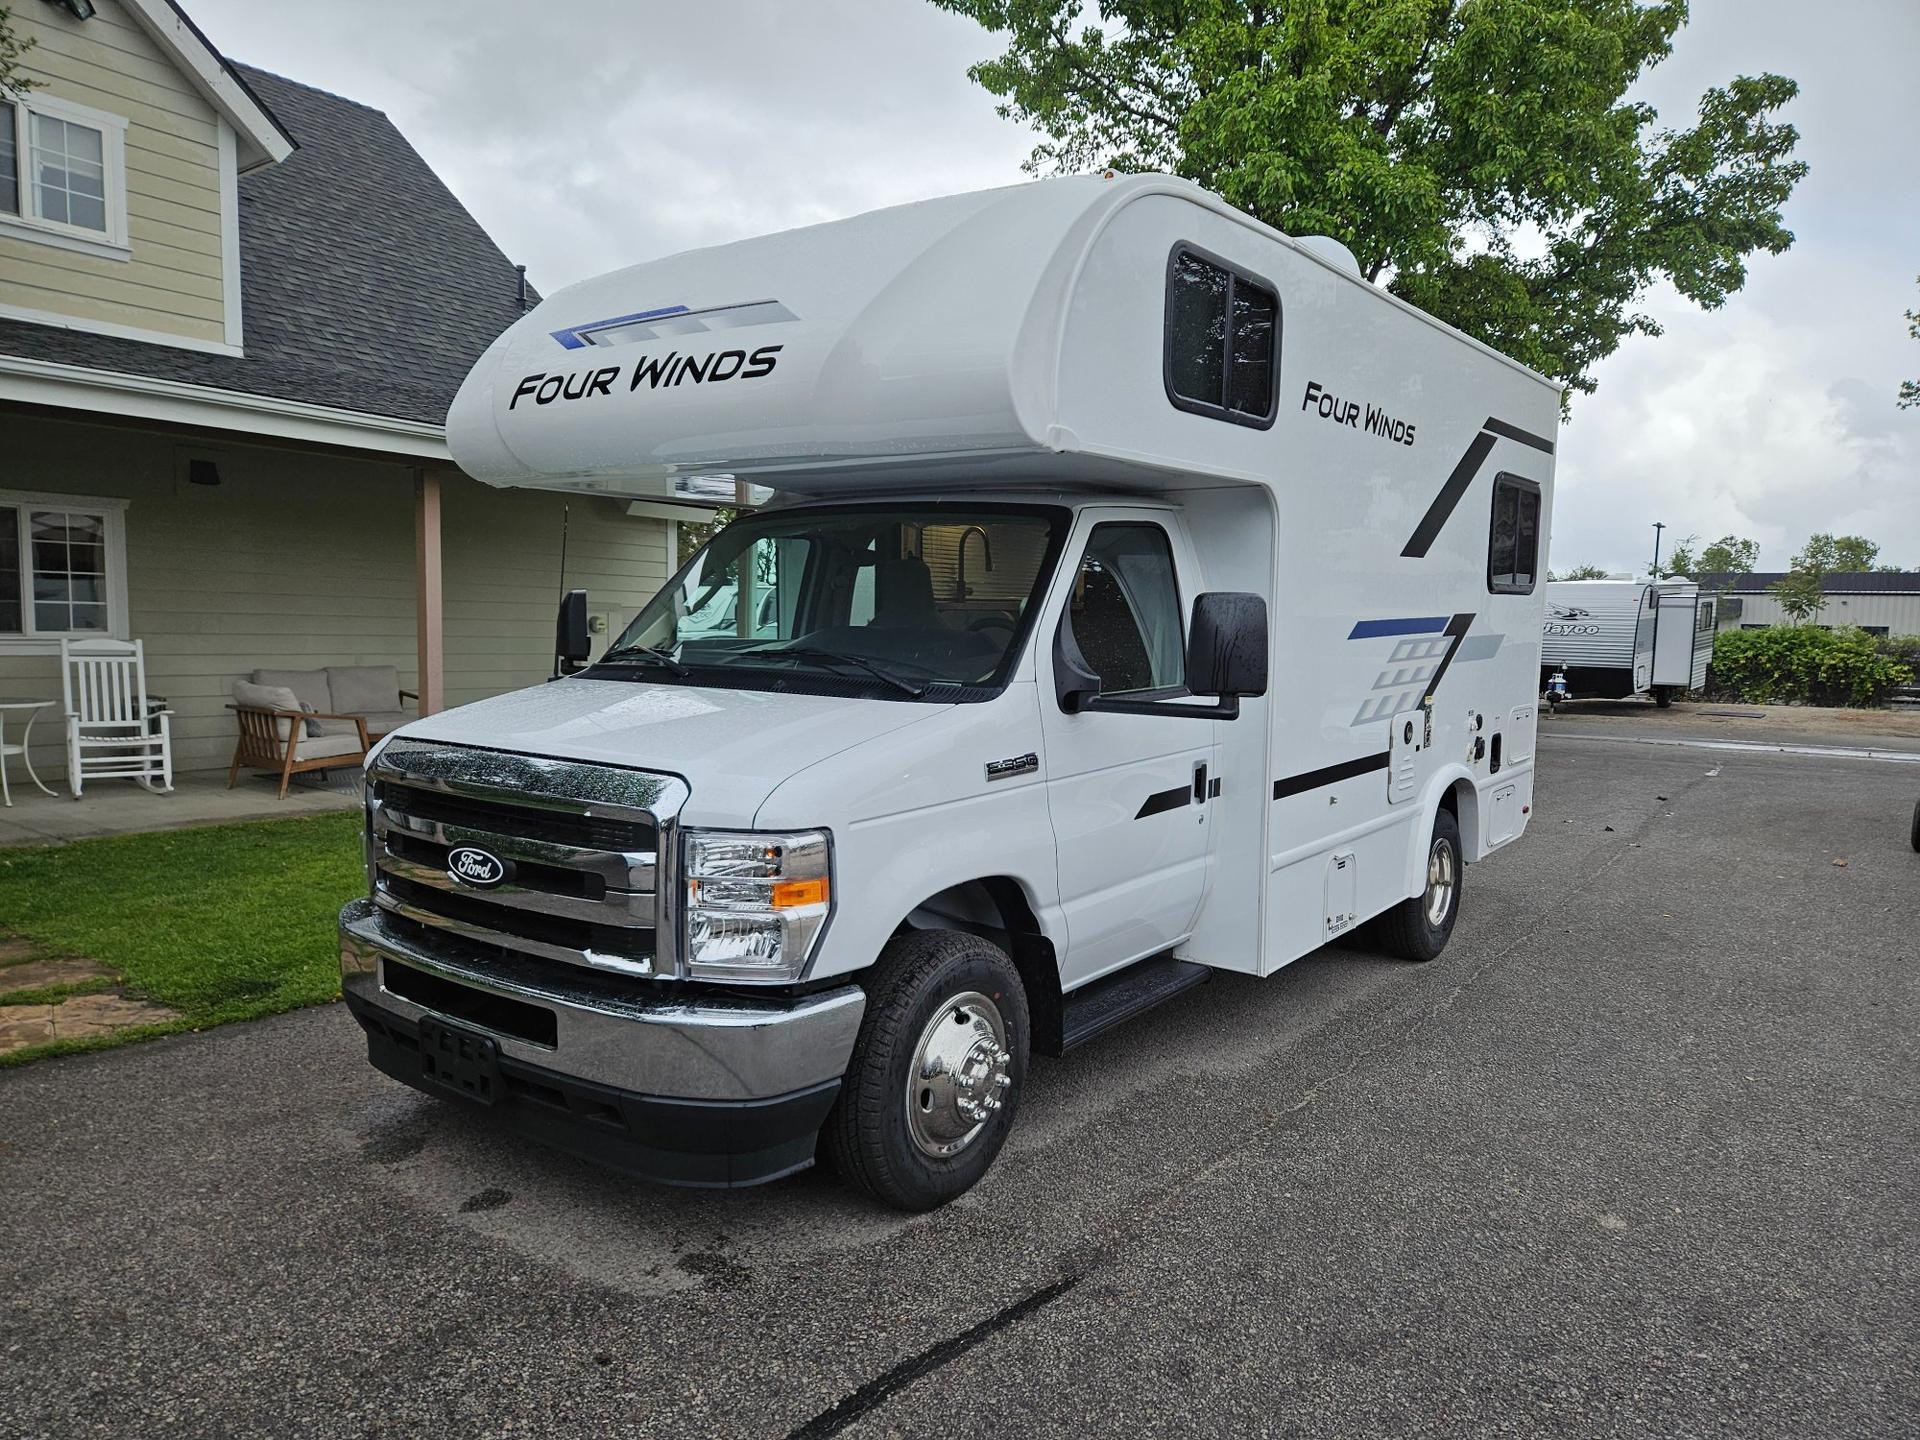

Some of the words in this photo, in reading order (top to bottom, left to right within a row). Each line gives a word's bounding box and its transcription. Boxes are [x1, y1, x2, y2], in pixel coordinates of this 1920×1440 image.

[509, 366, 621, 410] FOUR
[630, 344, 784, 392] WINDS
[1302, 381, 1360, 428] FOUR
[1365, 403, 1416, 446] WINDS
[458, 851, 492, 879] Ford
